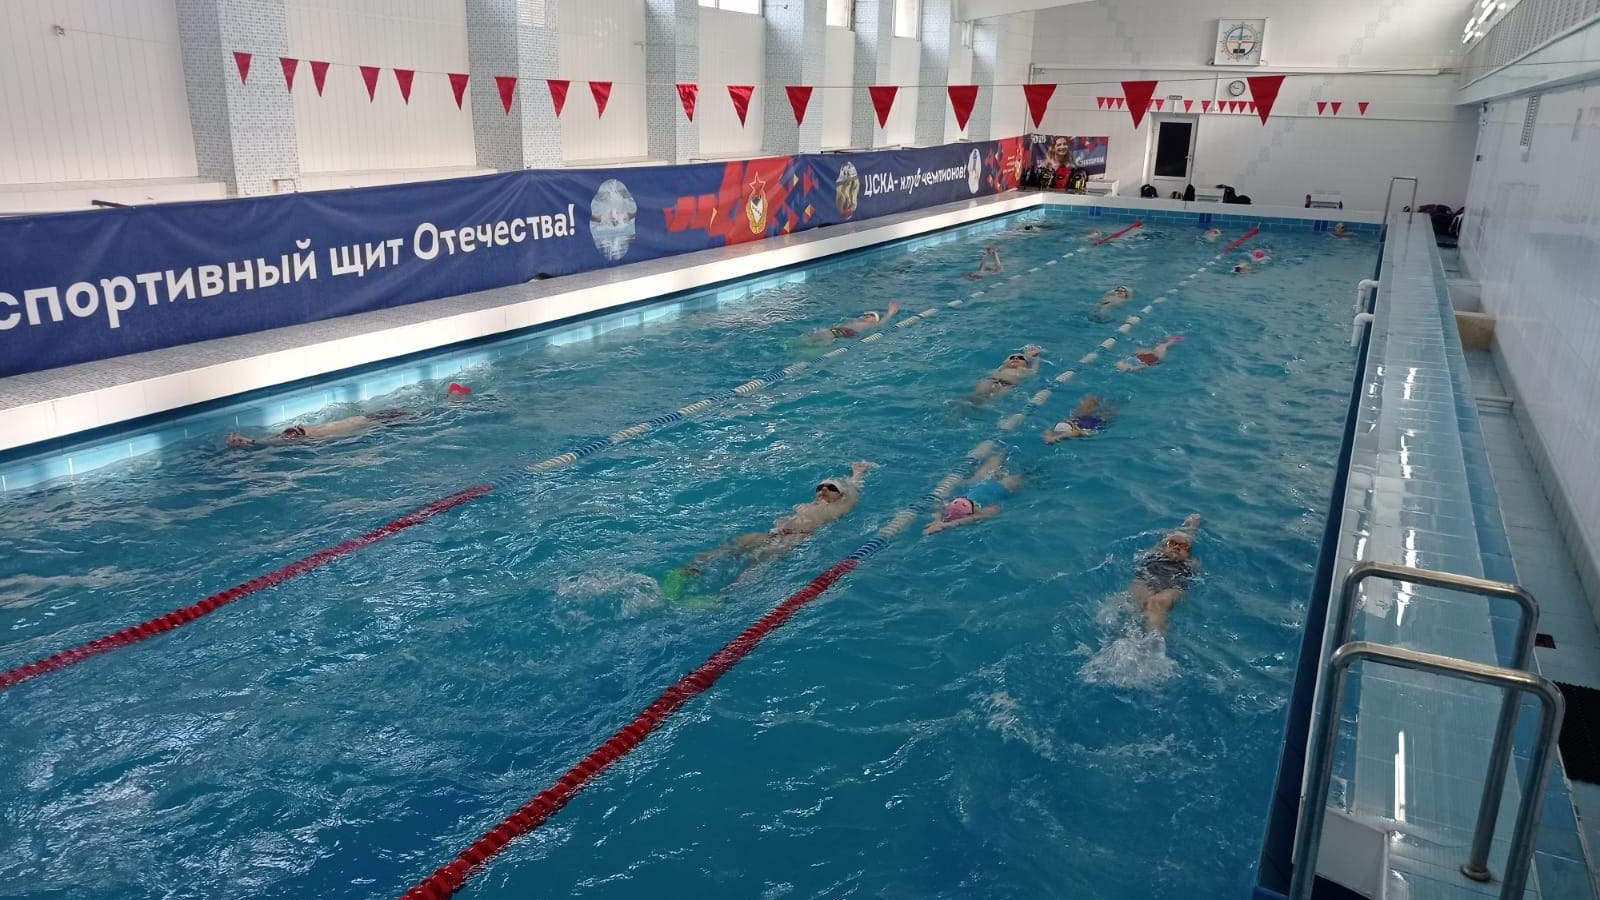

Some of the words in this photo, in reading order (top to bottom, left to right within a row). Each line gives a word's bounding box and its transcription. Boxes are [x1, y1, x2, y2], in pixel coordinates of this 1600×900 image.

[900, 167, 921, 194] клуб
[921, 164, 967, 186] чемпионов!
[0, 238, 317, 329] спортивный
[329, 238, 404, 278] щит
[413, 203, 576, 260] Отечества!
